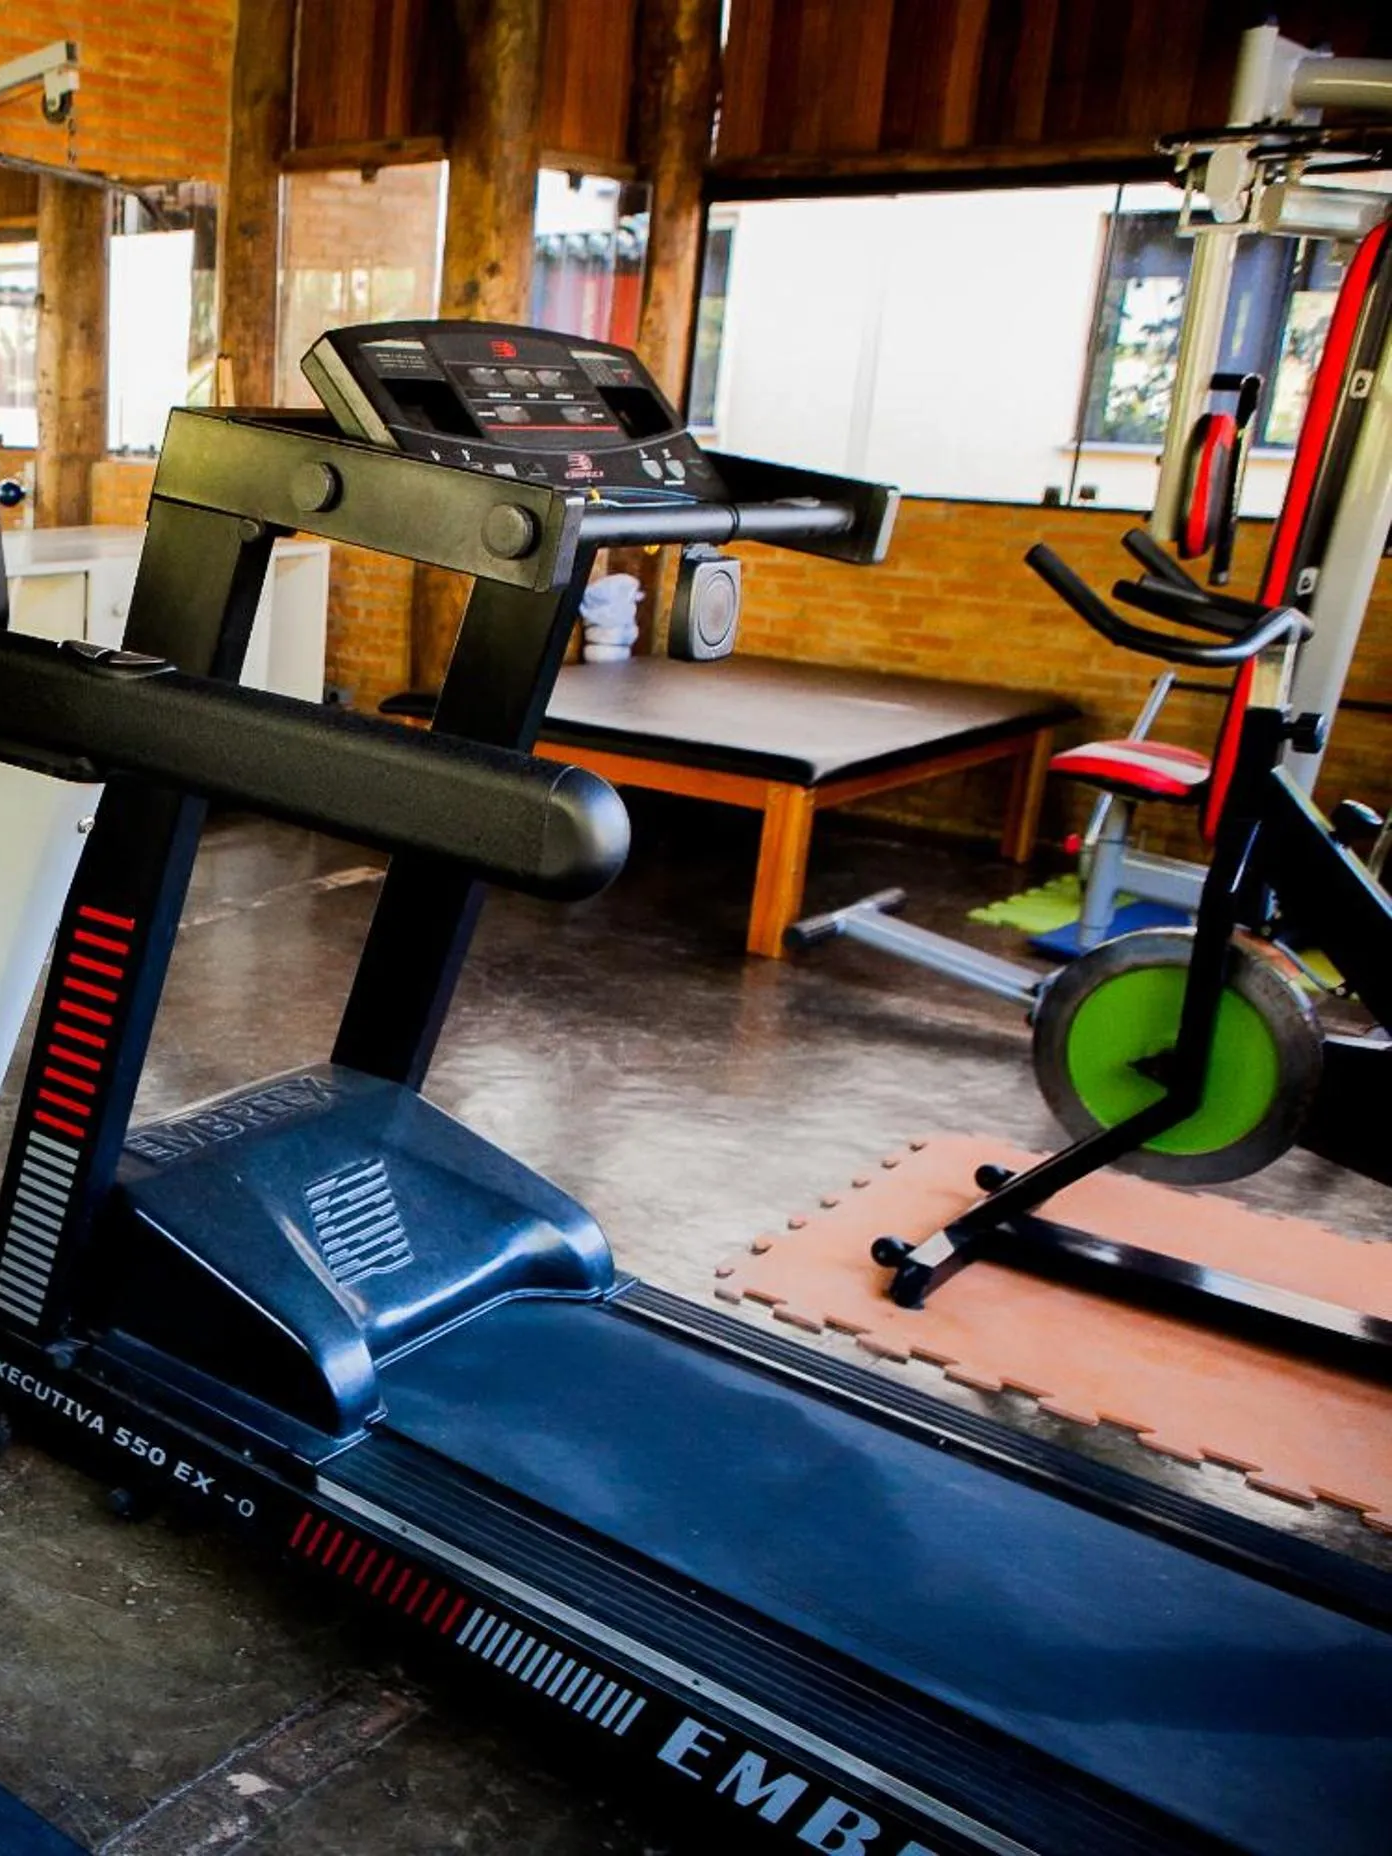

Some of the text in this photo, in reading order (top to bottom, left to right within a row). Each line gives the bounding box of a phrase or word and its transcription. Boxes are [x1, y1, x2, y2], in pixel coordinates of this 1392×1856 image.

[113, 1426, 167, 1466] 550
[173, 1460, 216, 1494] EX
[656, 1716, 941, 1856] EMB
